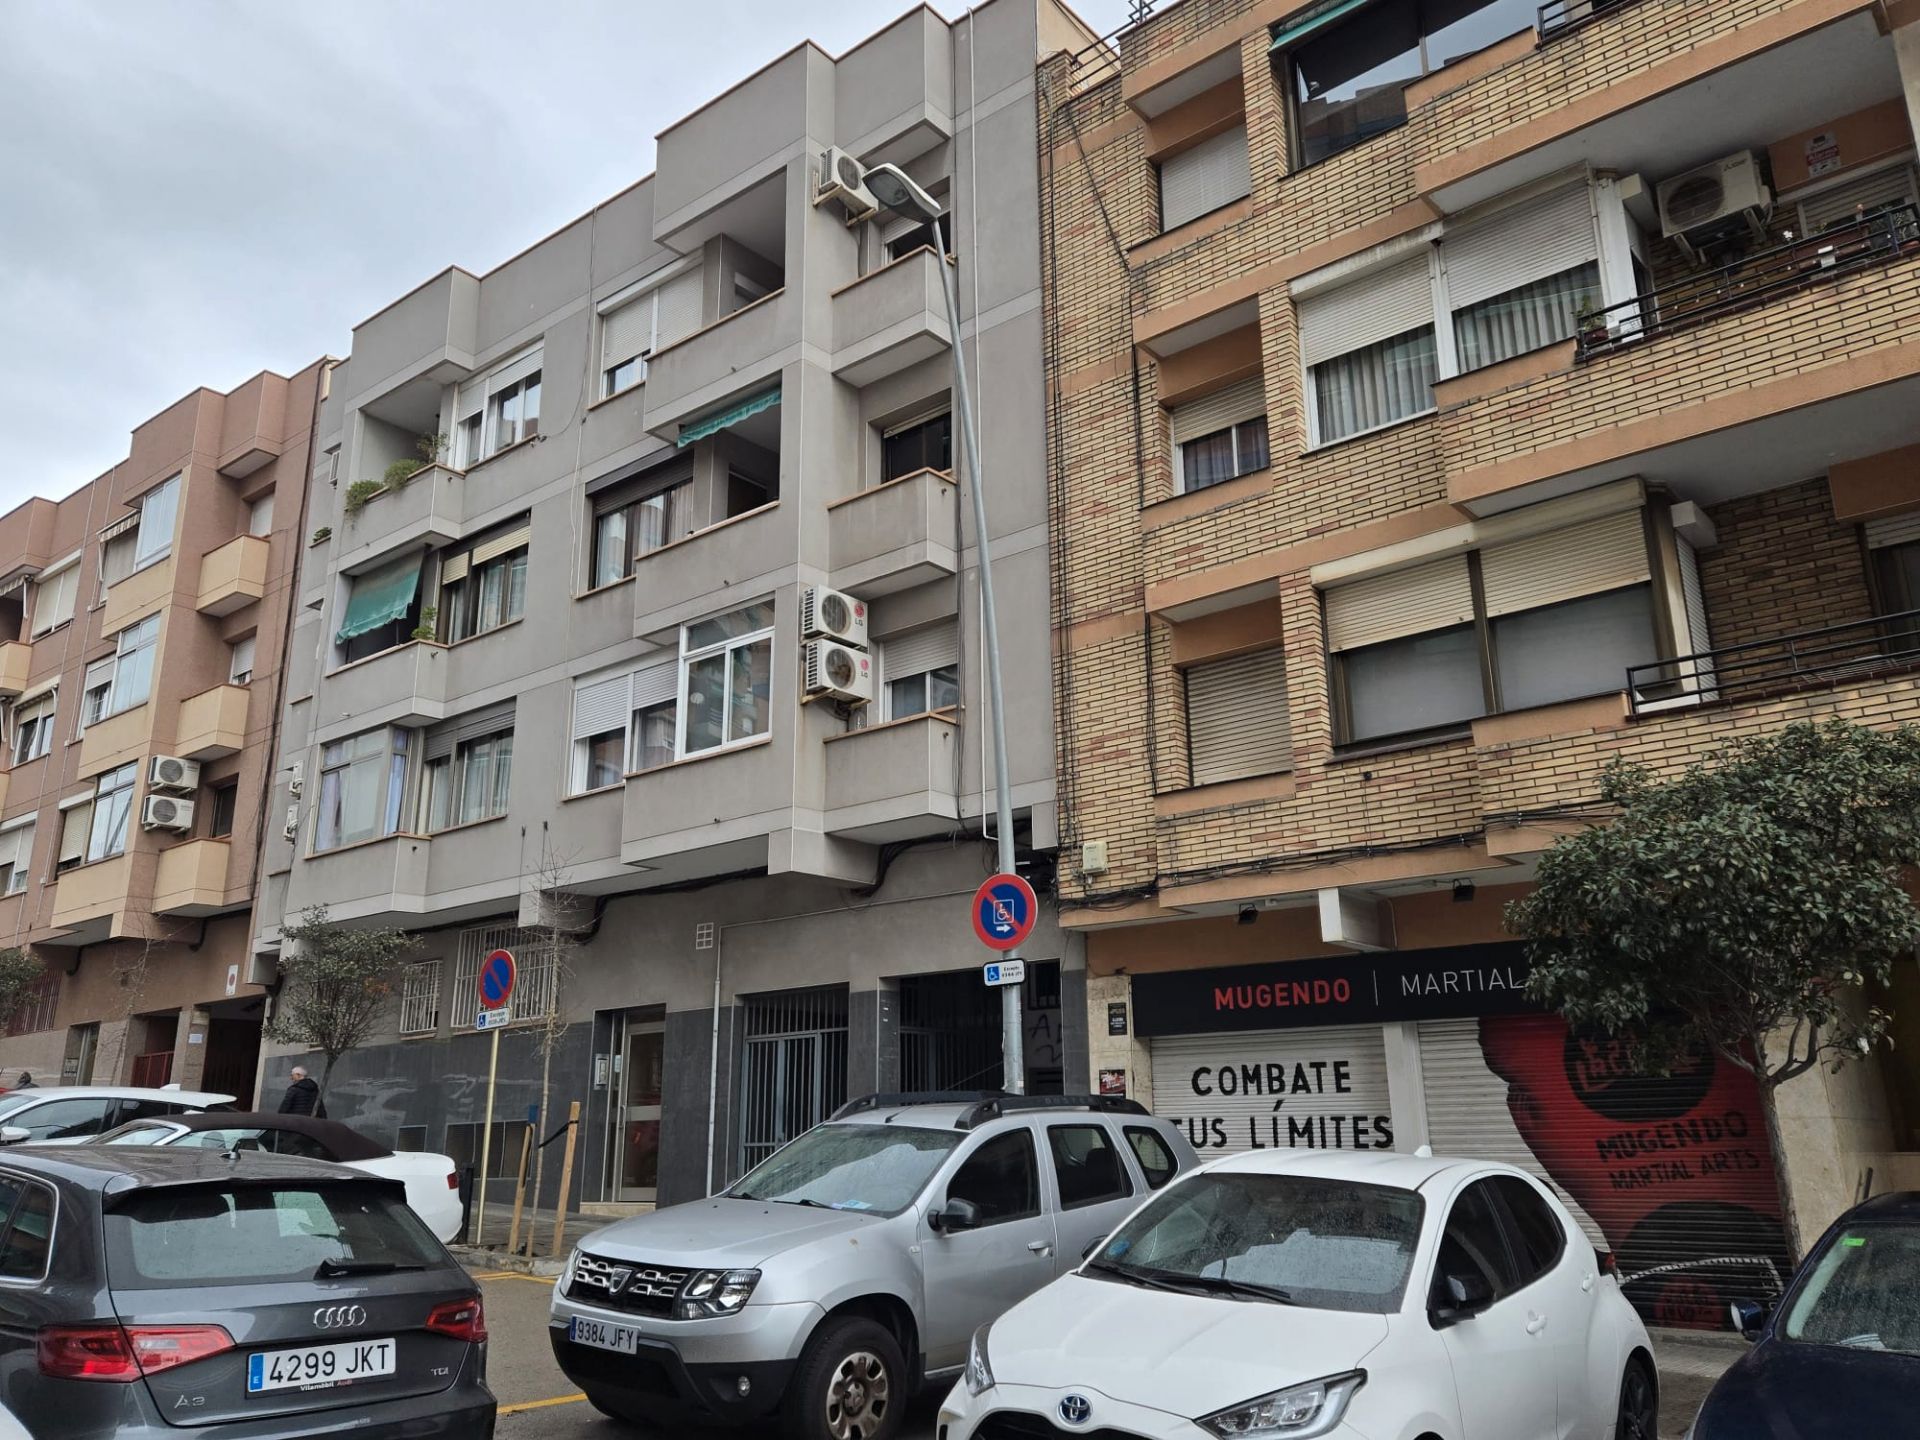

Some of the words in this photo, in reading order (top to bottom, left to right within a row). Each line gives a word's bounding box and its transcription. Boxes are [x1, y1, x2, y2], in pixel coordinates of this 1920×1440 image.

[1214, 978, 1351, 1011] MUGENDO
[1401, 966, 1522, 997] MARTIAL
[1191, 1060, 1353, 1096] COMBATE
[1169, 1117, 1228, 1149] US
[1250, 1099, 1395, 1150] LÍMITES
[1596, 1111, 1747, 1161] MUGENDO
[1608, 1158, 1695, 1191] MARTIAL
[1702, 1149, 1759, 1175] ARTS
[577, 1321, 605, 1344] 9384
[609, 1327, 634, 1350] JFY
[269, 1350, 335, 1383] 4299
[345, 1344, 390, 1374] JKT
[174, 1394, 205, 1409] A3
